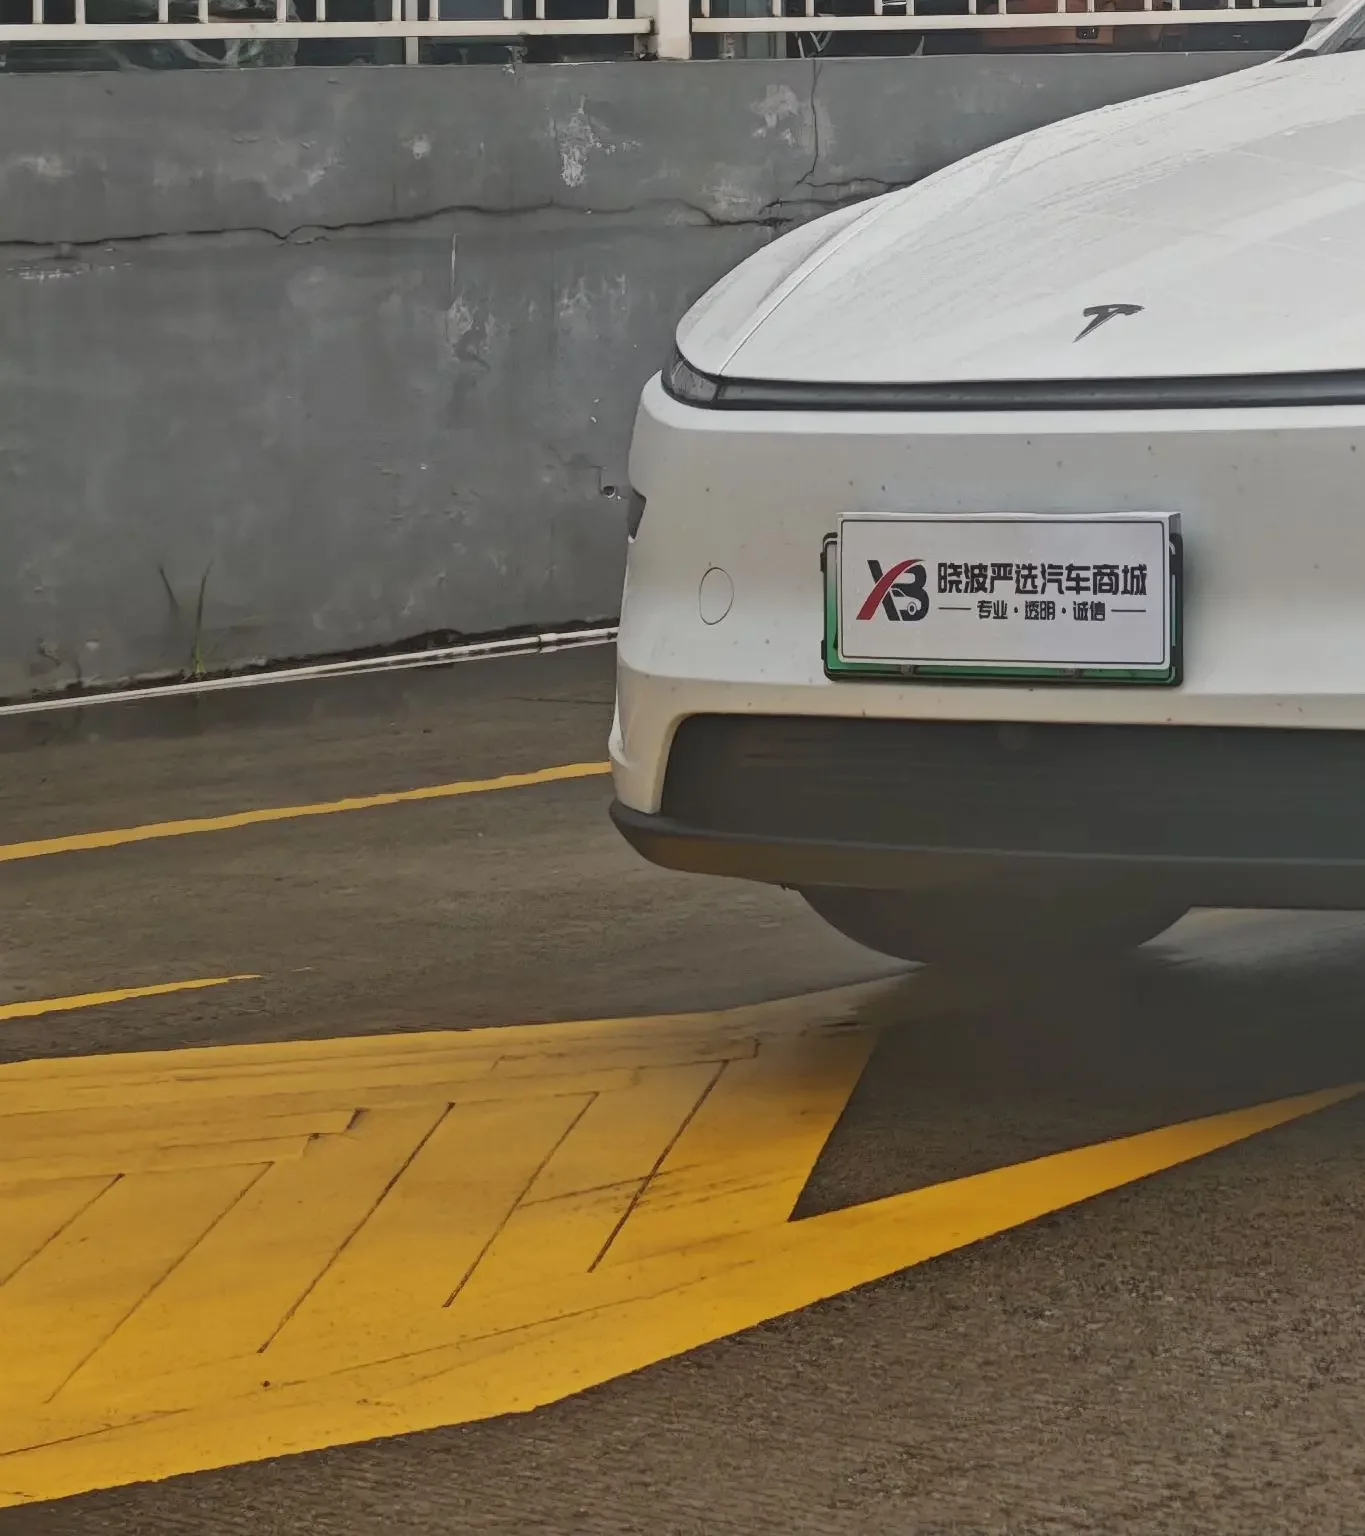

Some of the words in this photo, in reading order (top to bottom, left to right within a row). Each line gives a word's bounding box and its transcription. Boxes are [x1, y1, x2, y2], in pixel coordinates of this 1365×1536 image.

[937, 561, 1148, 597] 晓波严选汽车商城
